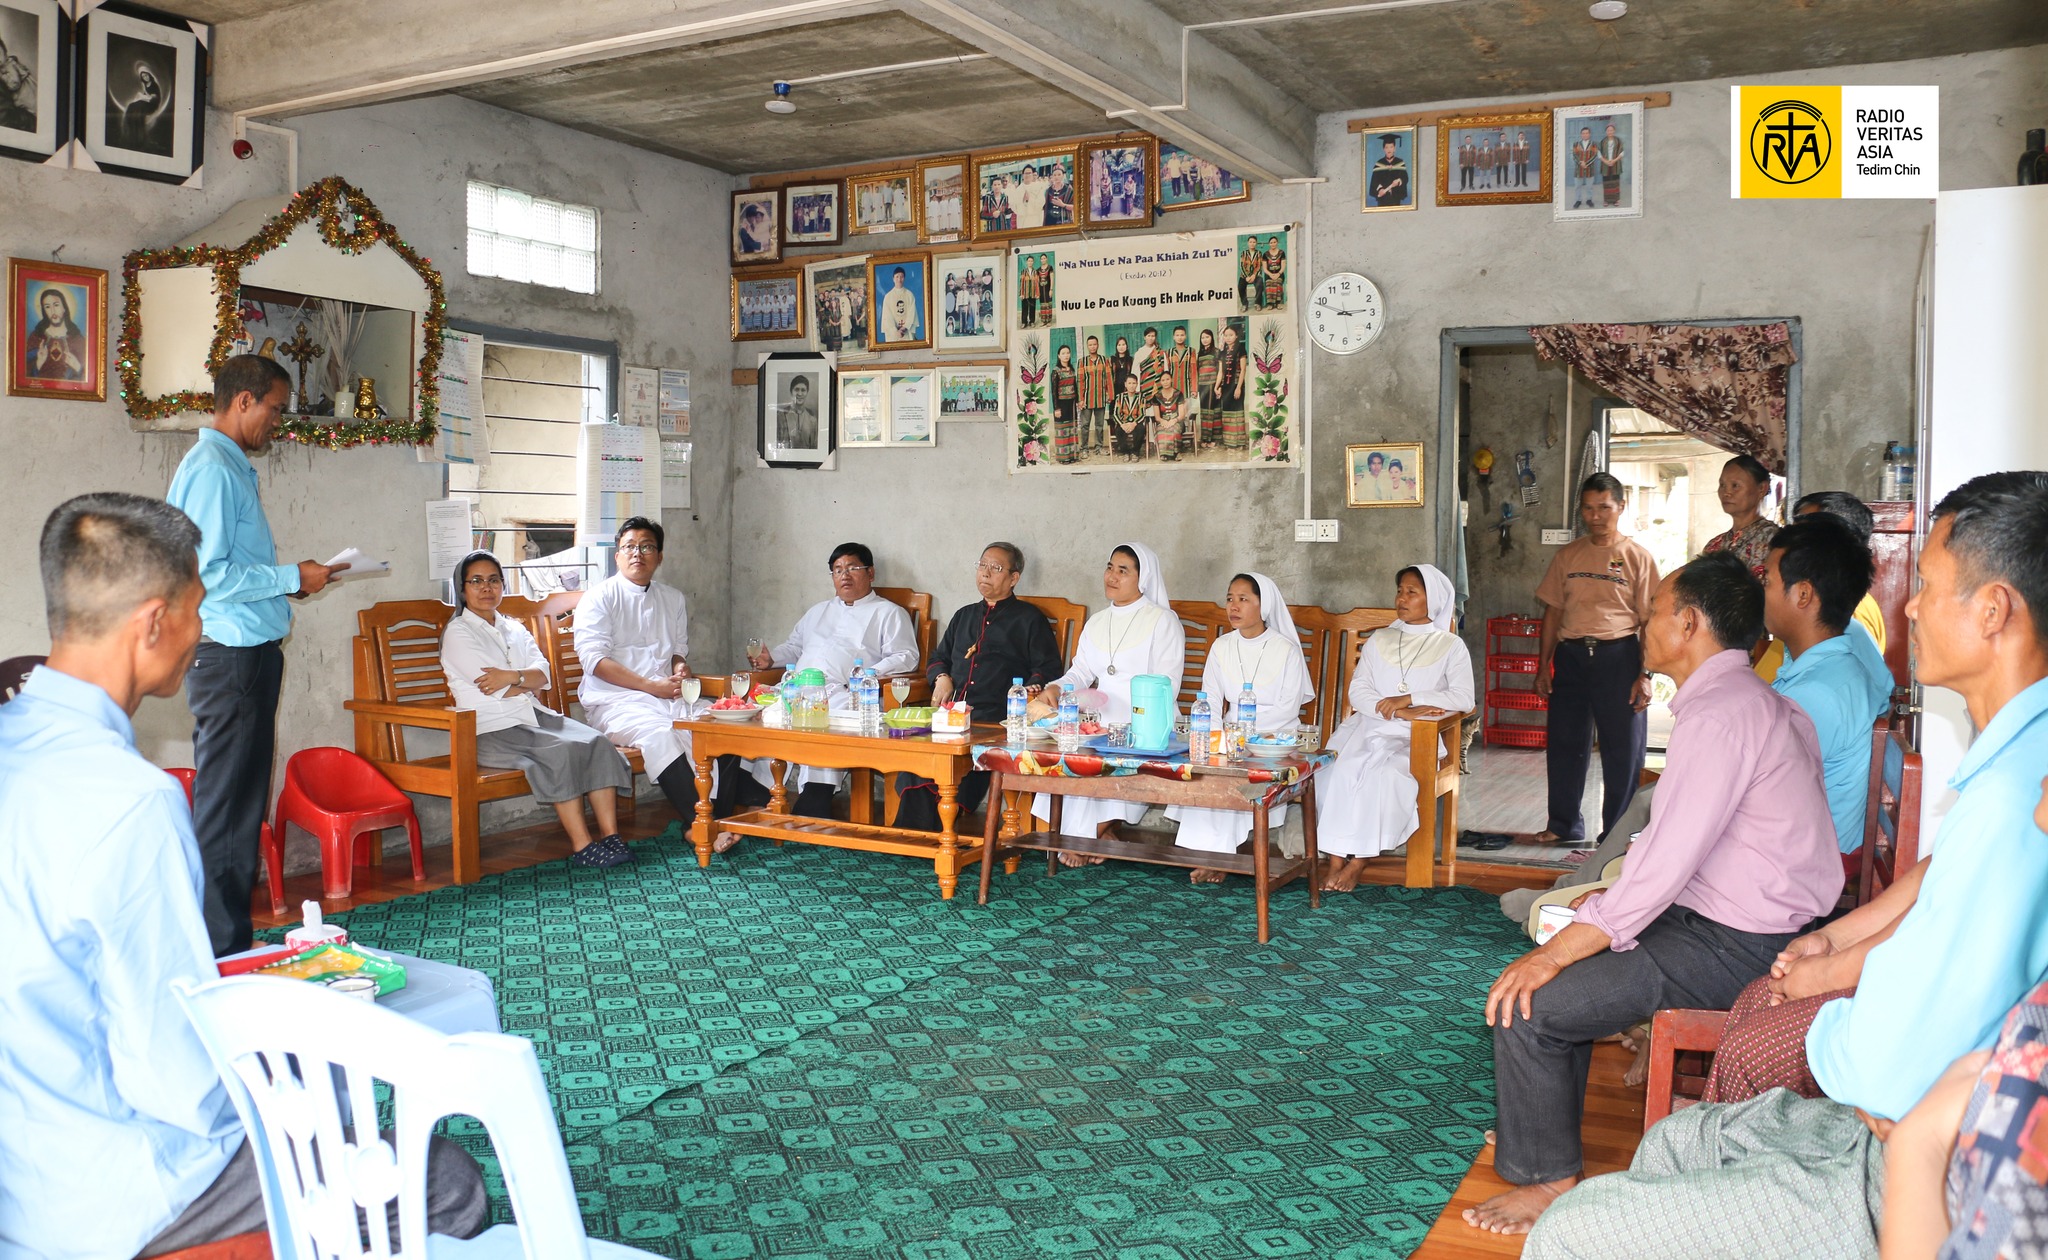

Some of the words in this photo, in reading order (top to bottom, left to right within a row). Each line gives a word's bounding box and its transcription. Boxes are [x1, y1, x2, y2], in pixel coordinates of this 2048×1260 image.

[1079, 260, 1100, 268] Nuu
[1103, 258, 1115, 266] Le
[1118, 256, 1132, 265] Na
[1135, 255, 1153, 263] Paa
[1156, 252, 1189, 262] Khiah
[1192, 250, 1210, 259] Zul
[1328, 286, 1336, 294] 11
[1340, 282, 1350, 290] 12
[1061, 300, 1081, 311] Nuu
[1084, 299, 1096, 310] Le
[1099, 298, 1119, 308] Paa
[1122, 295, 1157, 308] Kuang
[1160, 293, 1173, 304] Eh
[1176, 290, 1204, 303] Hnak
[1208, 287, 1233, 301] Puai
[1318, 296, 1328, 306] 10
[1366, 294, 1372, 303] 2
[1316, 310, 1321, 318] 9
[1370, 308, 1376, 316] 3
[1319, 324, 1325, 332] 8
[1329, 334, 1335, 342] 7
[1342, 337, 1348, 346] 6
